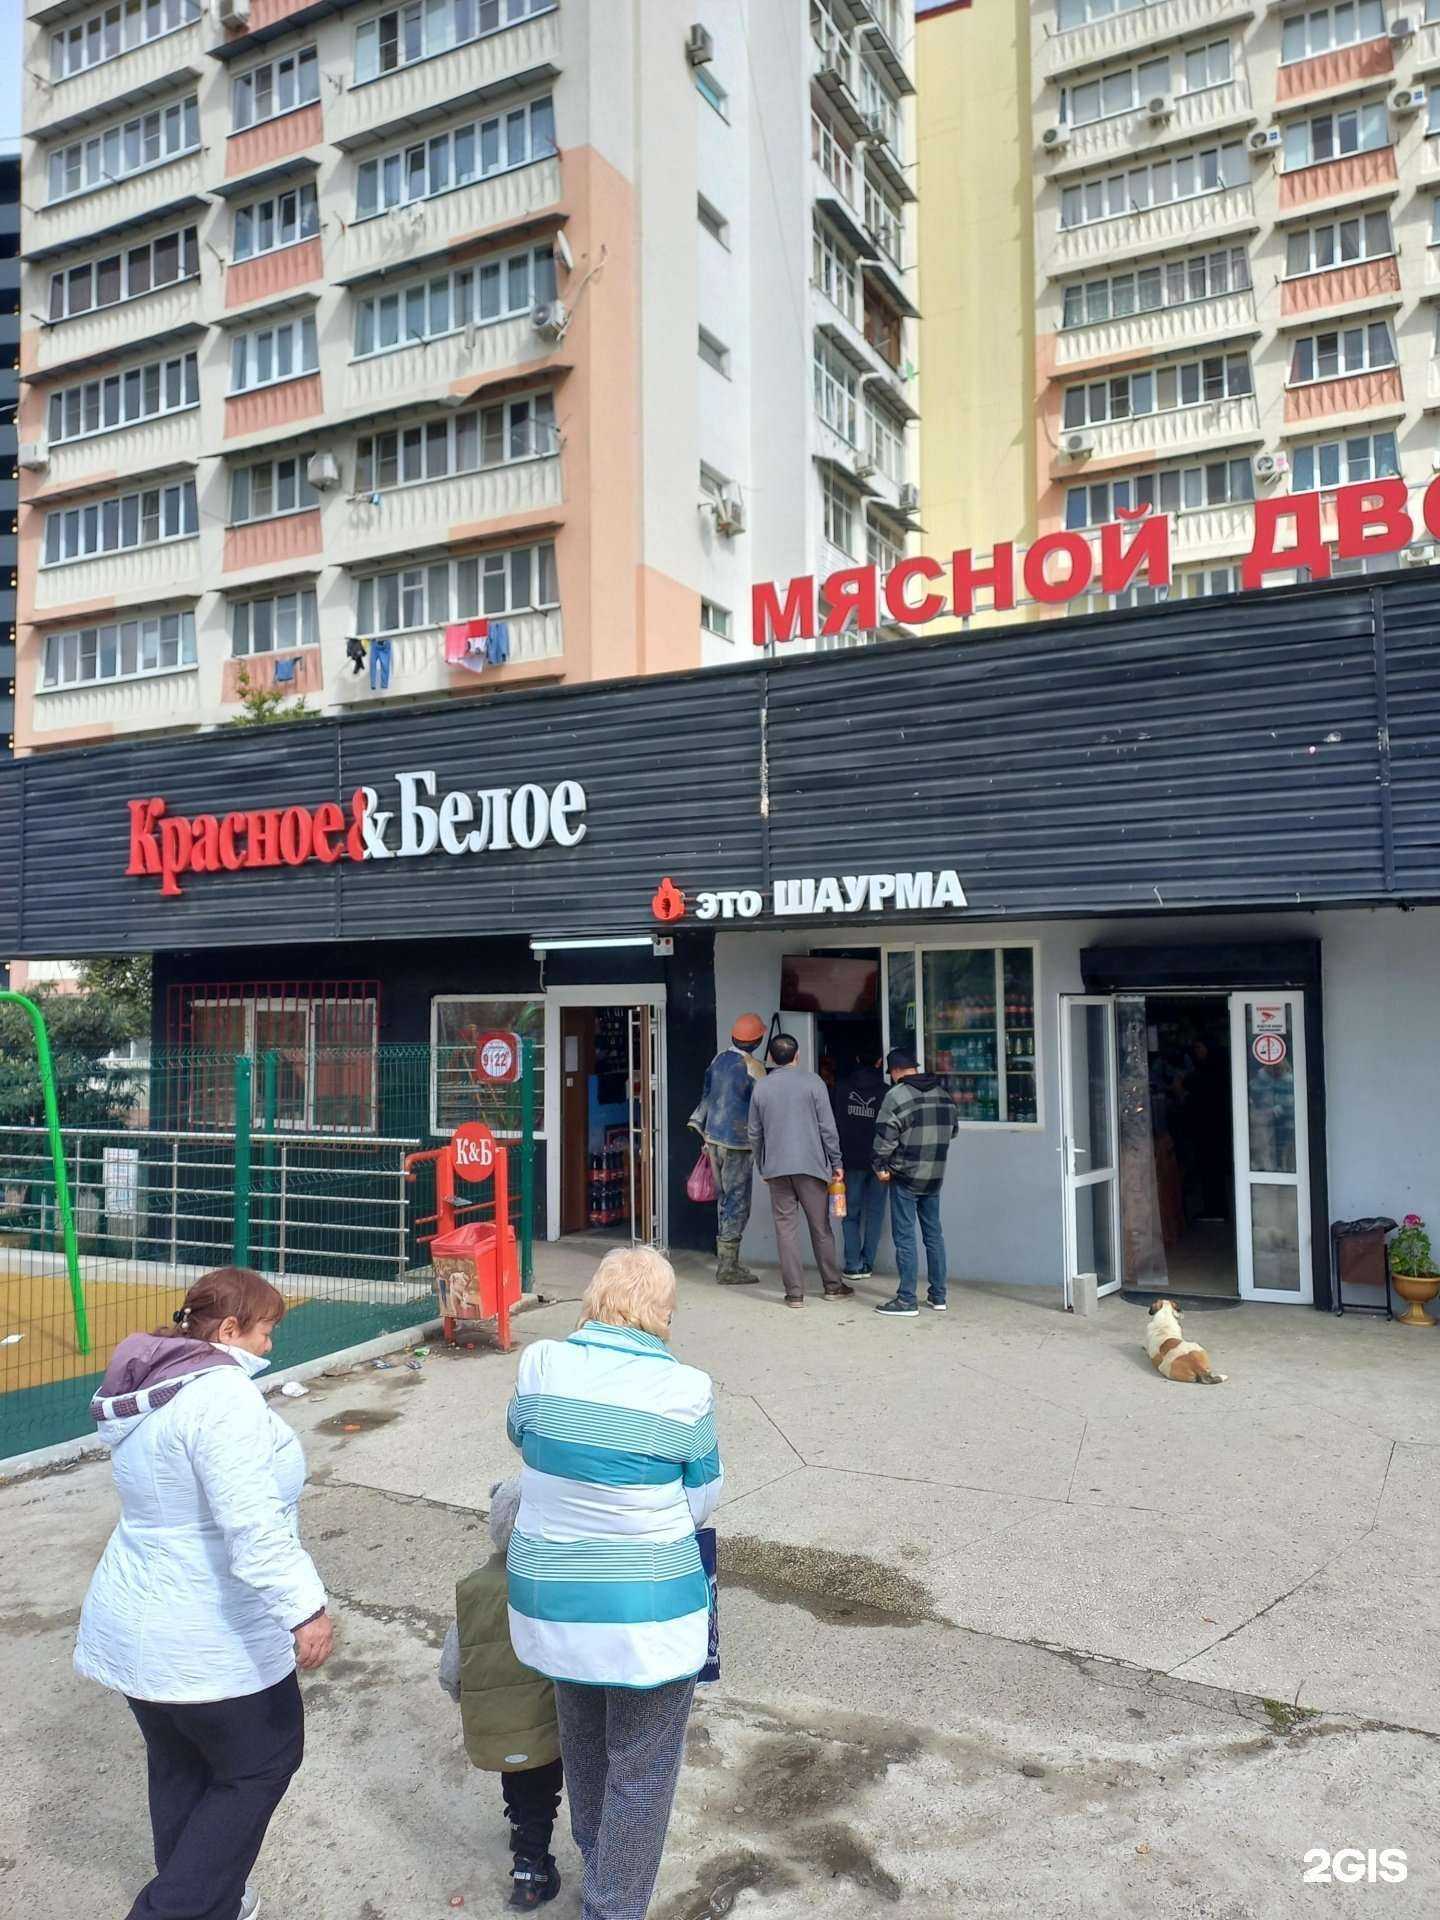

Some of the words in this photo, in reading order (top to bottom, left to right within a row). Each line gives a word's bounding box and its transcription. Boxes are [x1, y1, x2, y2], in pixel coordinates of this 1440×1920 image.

[752, 502, 1172, 645] МЯСНОЙ
[1239, 476, 1440, 588] ДВ
[773, 870, 968, 916] ШАУРМА
[455, 1137, 493, 1166] К&Б
